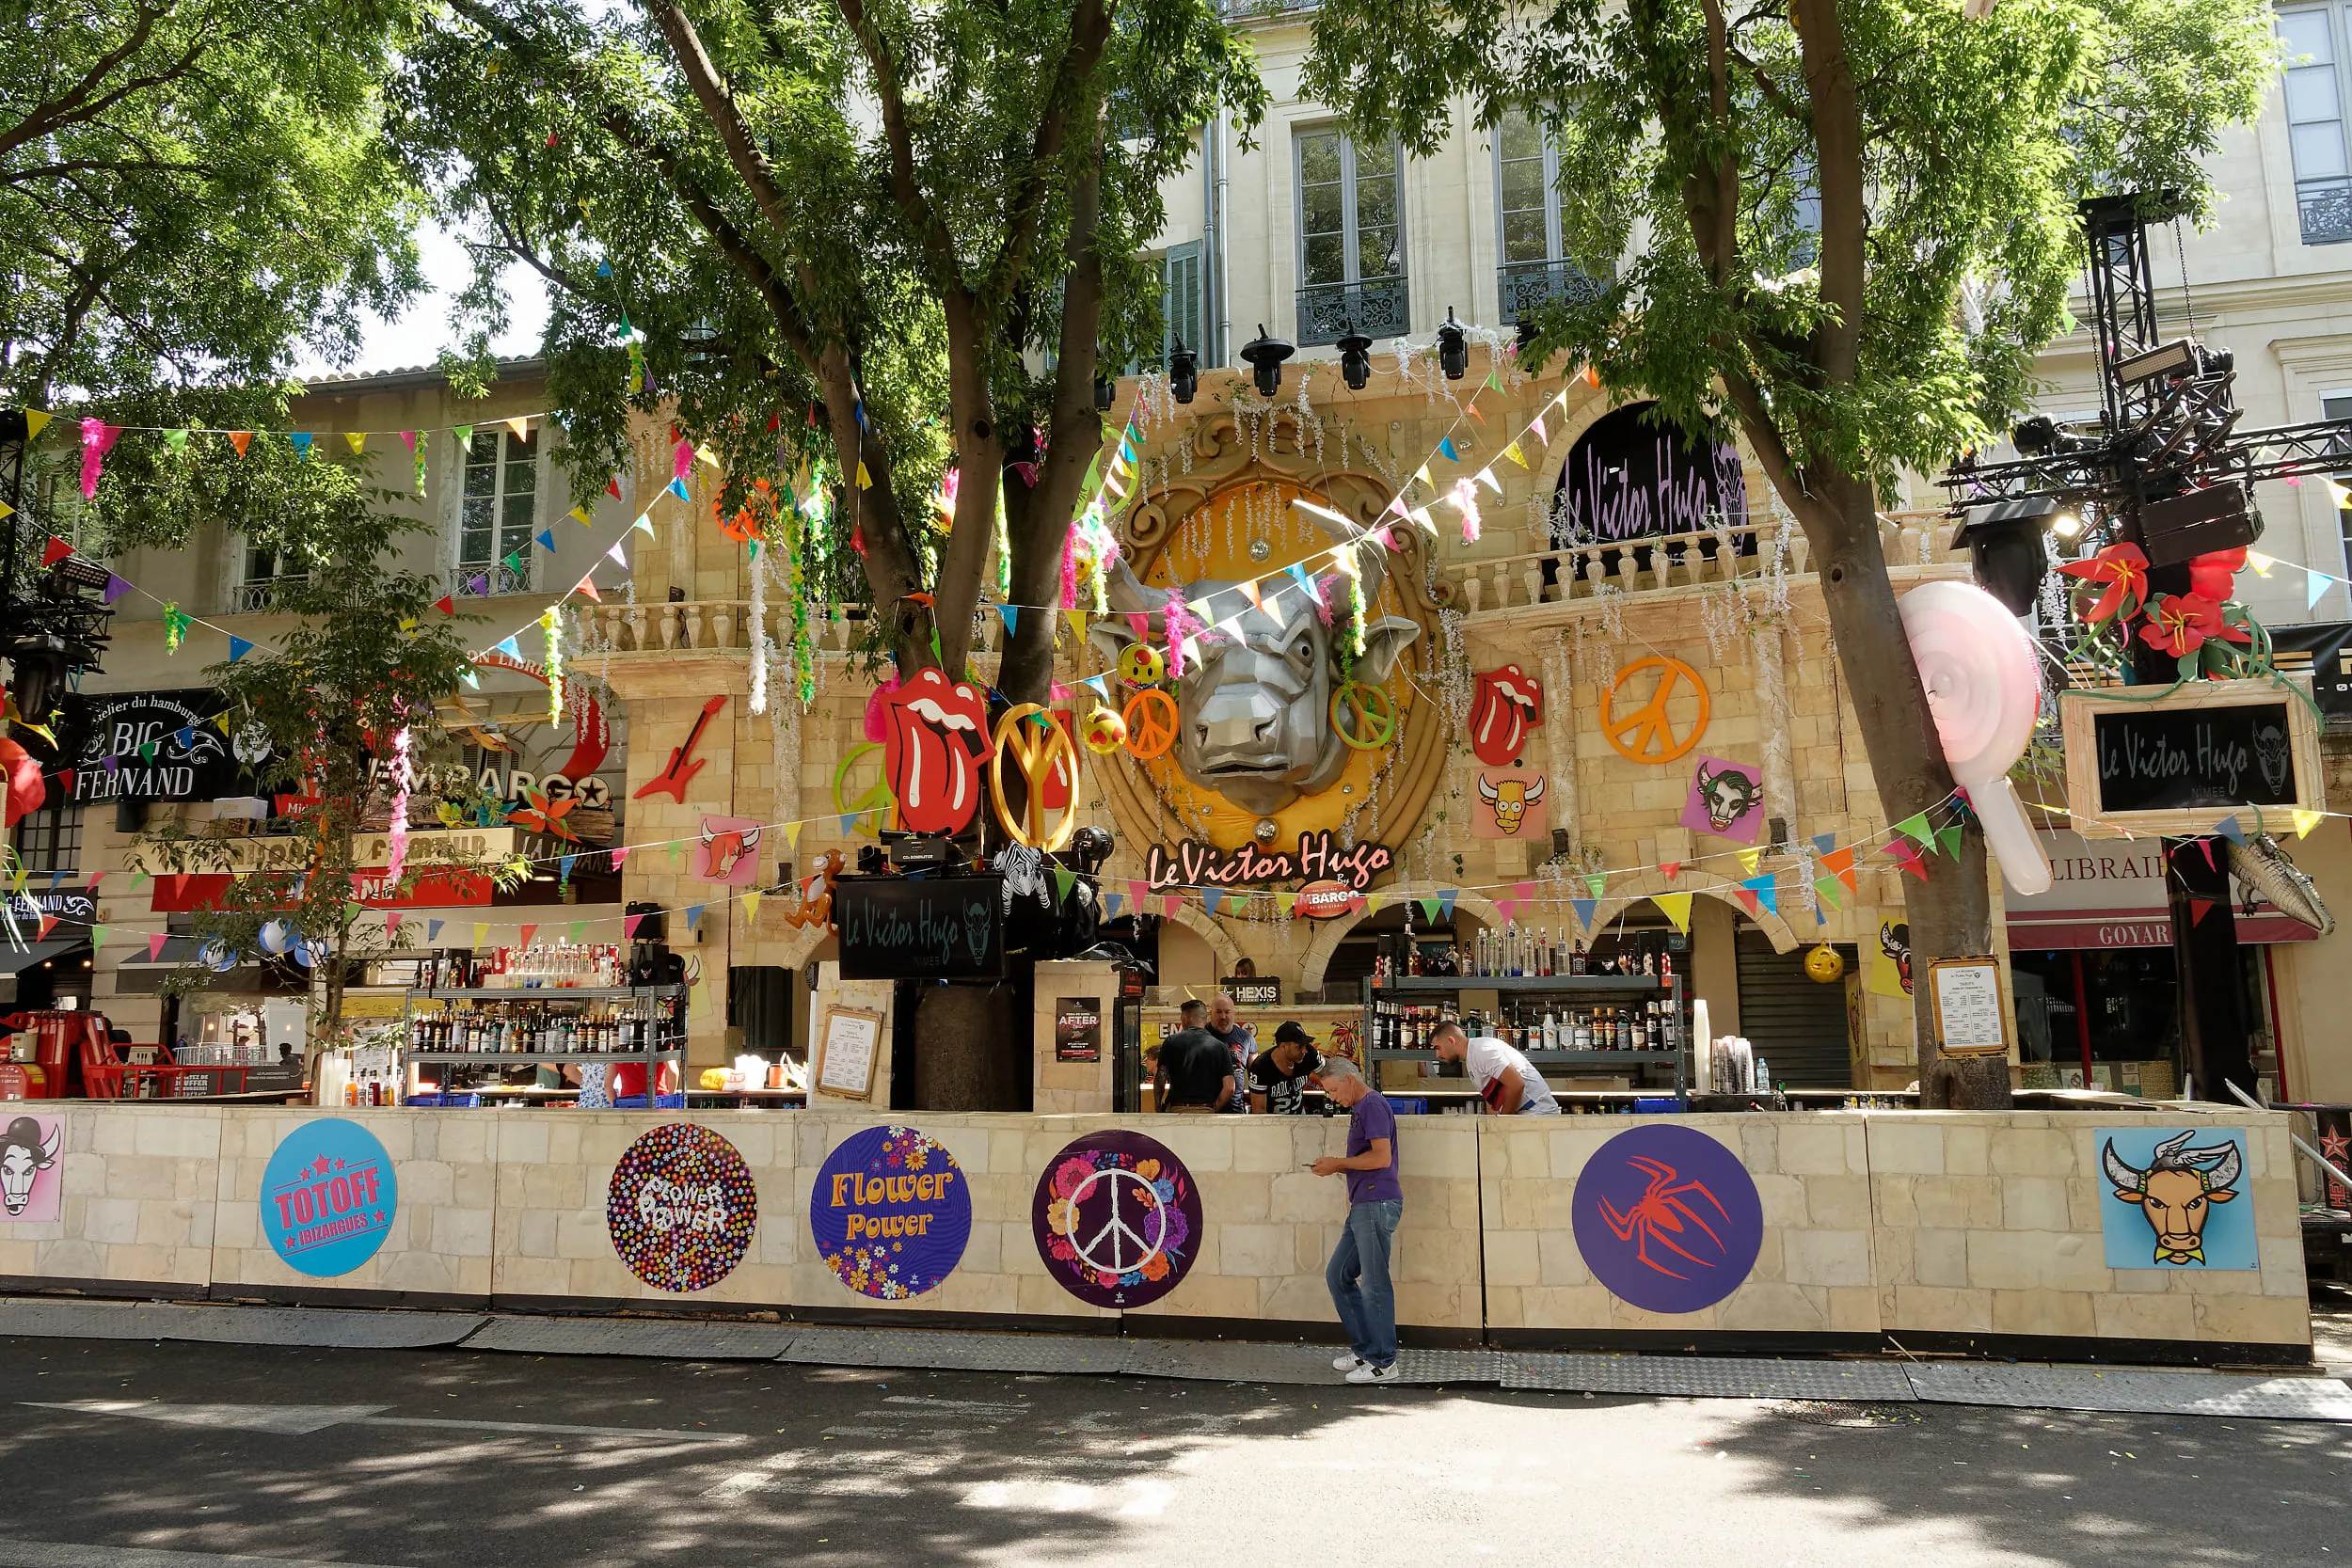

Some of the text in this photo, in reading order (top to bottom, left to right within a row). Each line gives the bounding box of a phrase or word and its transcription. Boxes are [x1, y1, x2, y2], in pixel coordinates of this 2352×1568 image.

[1587, 443, 1652, 540] Victor
[1657, 435, 1708, 534] Hugo
[467, 649, 490, 663] ON
[131, 695, 147, 708] du
[151, 694, 204, 726] hamburgé
[113, 721, 163, 757] BIG
[2100, 722, 2249, 796] Le Victor Hugo
[74, 767, 194, 800] FERNAND
[522, 835, 543, 860] LA
[1150, 830, 1391, 890] Le Victor Hugo
[1337, 873, 1350, 888] By
[1293, 890, 1359, 906] MBARGO
[847, 896, 960, 966] Le Victor Hugo
[2099, 925, 2169, 945] GOYAR
[1235, 986, 1277, 999] HEXIS
[1058, 1016, 1098, 1025] AFTER
[1249, 1071, 1258, 1084] 23
[275, 1166, 380, 1229] TOTOFF
[830, 1172, 954, 1208] Flower
[2328, 1159, 2347, 1208] HEXS
[298, 1212, 368, 1245] IBIZARGUES
[638, 1194, 729, 1235] POWER
[846, 1213, 934, 1241] Power
